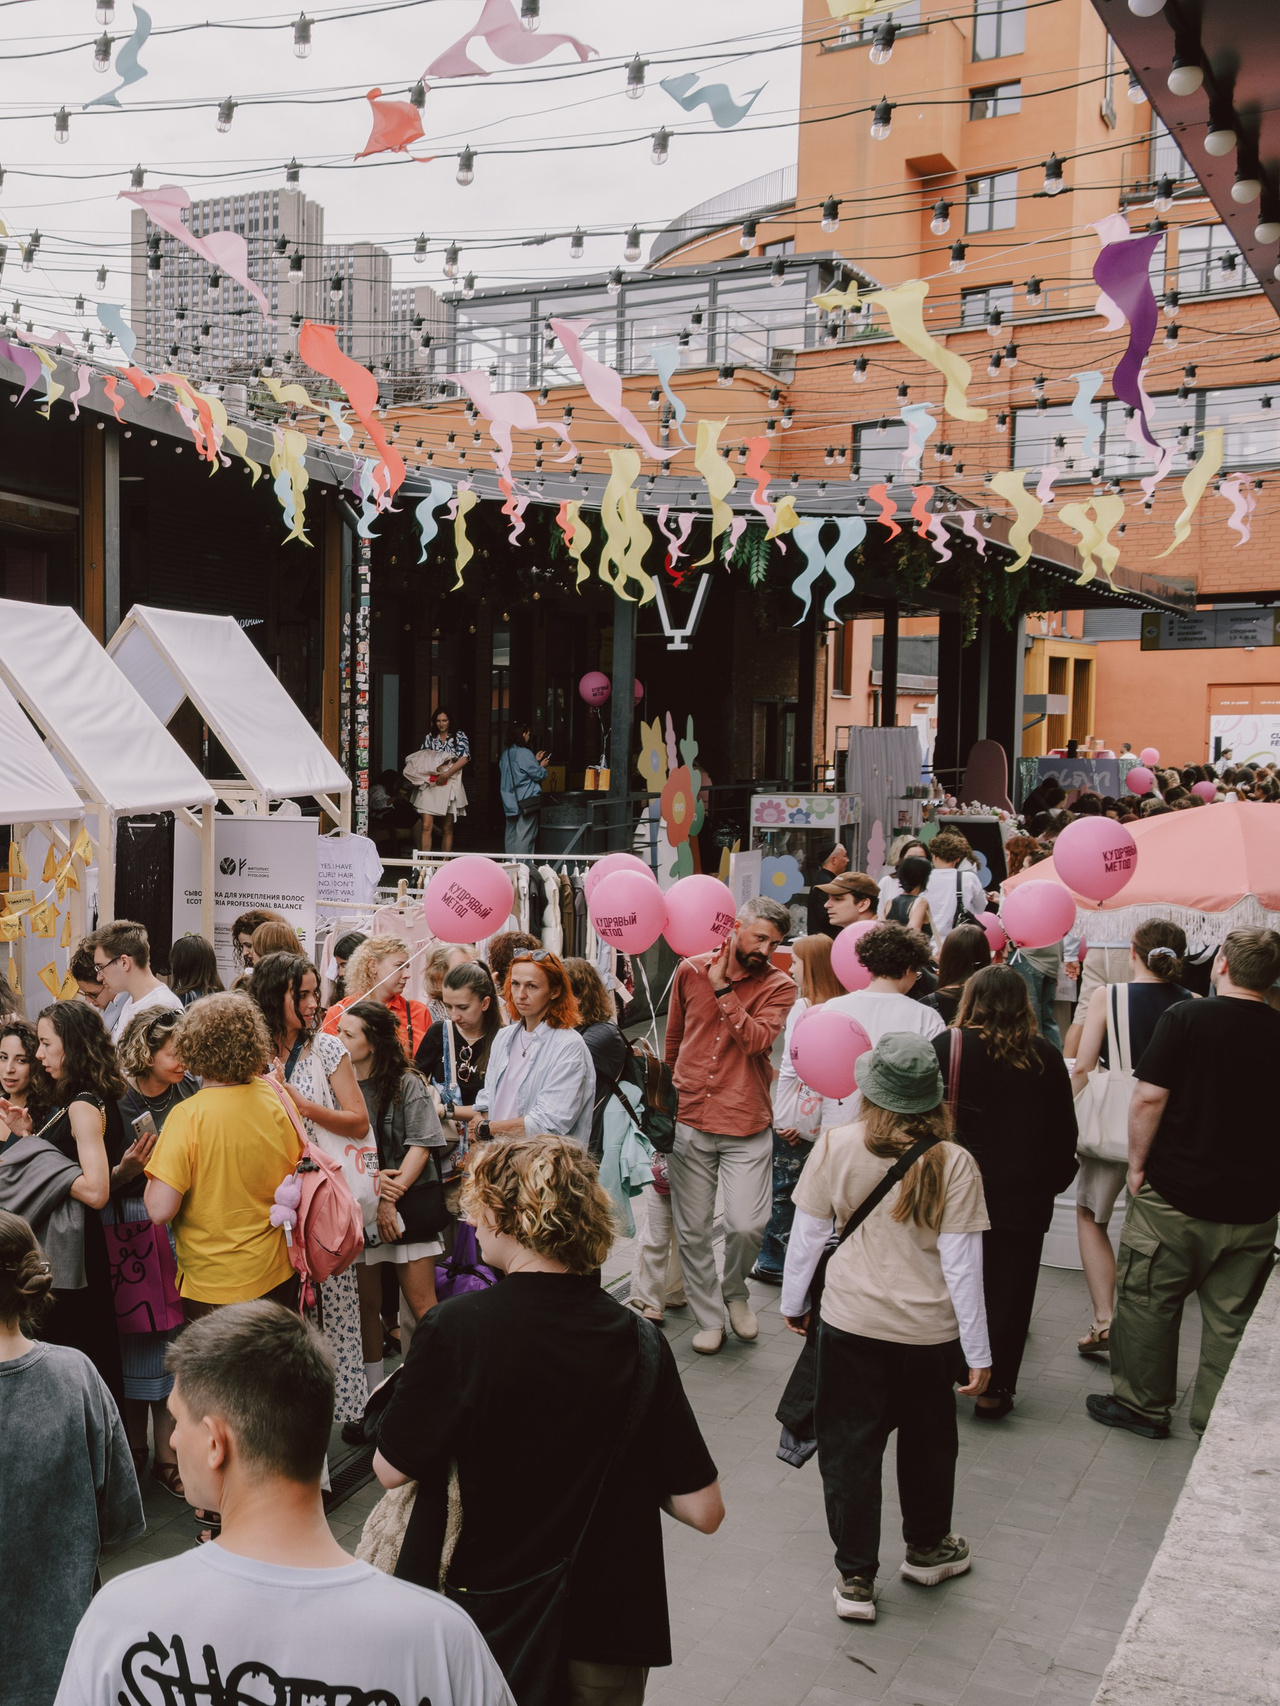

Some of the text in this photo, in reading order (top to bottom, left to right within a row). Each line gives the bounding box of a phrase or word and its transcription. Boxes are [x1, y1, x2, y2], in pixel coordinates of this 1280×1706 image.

[1105, 858, 1131, 872] МЕТОД
[281, 894, 305, 902] ВОЛОС
[440, 892, 468, 918] МЕТОД
[448, 882, 493, 920] КУДРЯВЫЙ
[595, 912, 637, 928] КУДРЯВЫЙ
[600, 928, 624, 937] МЕТОД
